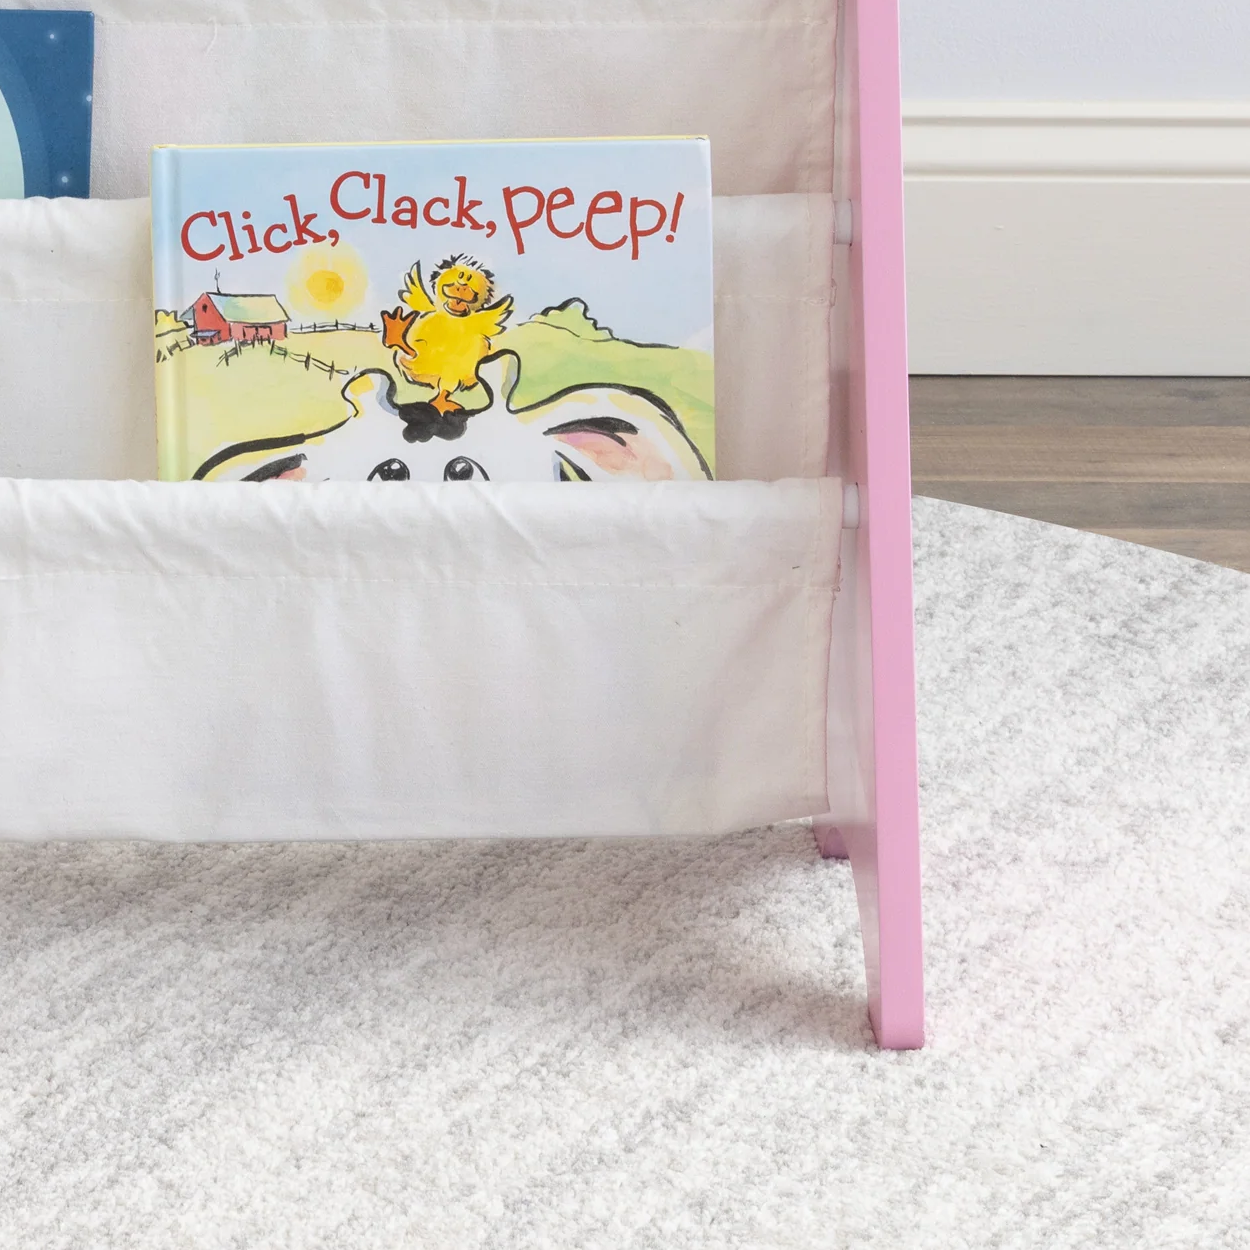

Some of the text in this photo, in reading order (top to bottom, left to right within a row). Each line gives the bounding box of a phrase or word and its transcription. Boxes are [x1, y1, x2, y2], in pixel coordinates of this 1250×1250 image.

[181, 170, 685, 262] Click, Clack, peep!
